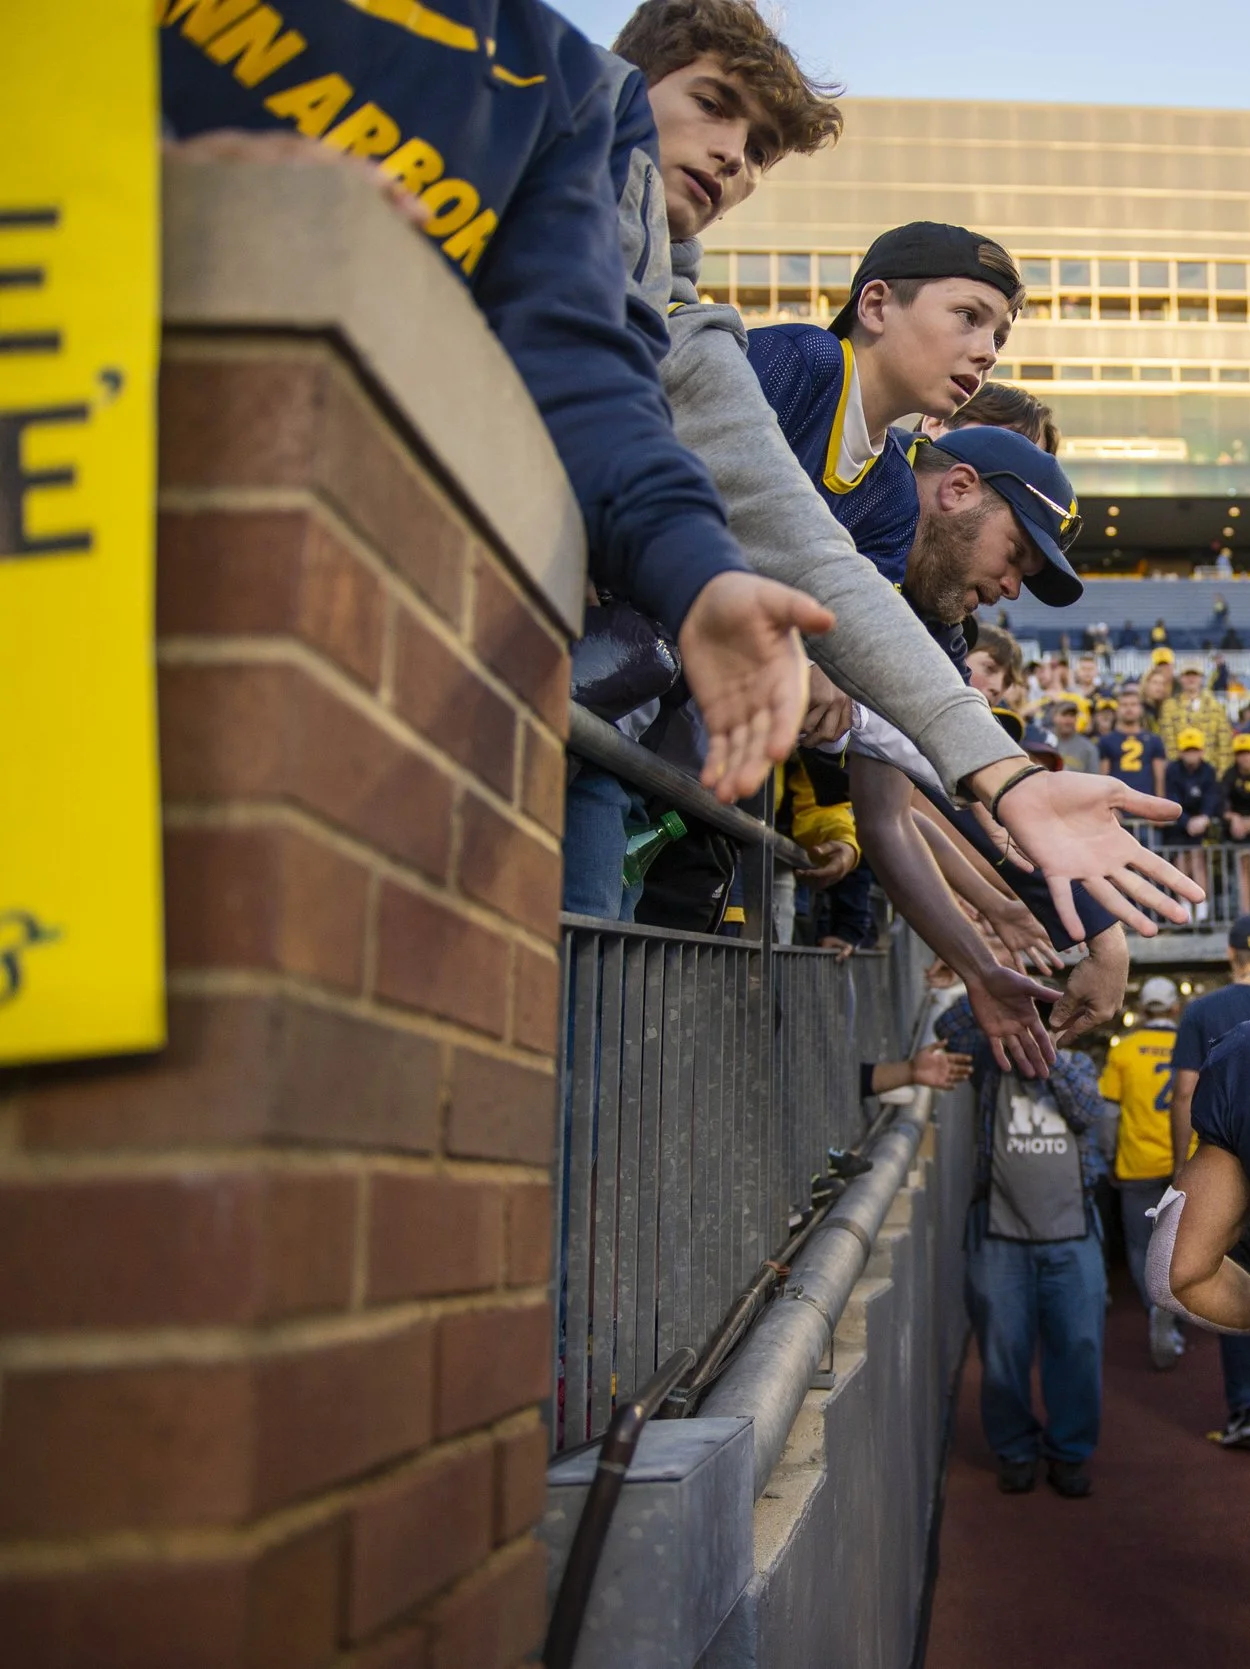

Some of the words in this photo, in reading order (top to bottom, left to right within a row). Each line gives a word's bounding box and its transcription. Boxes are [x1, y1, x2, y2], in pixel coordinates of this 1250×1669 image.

[1119, 735, 1144, 772] 2
[1154, 1062, 1176, 1111] 2
[1007, 1137, 1067, 1154] PHOTO
